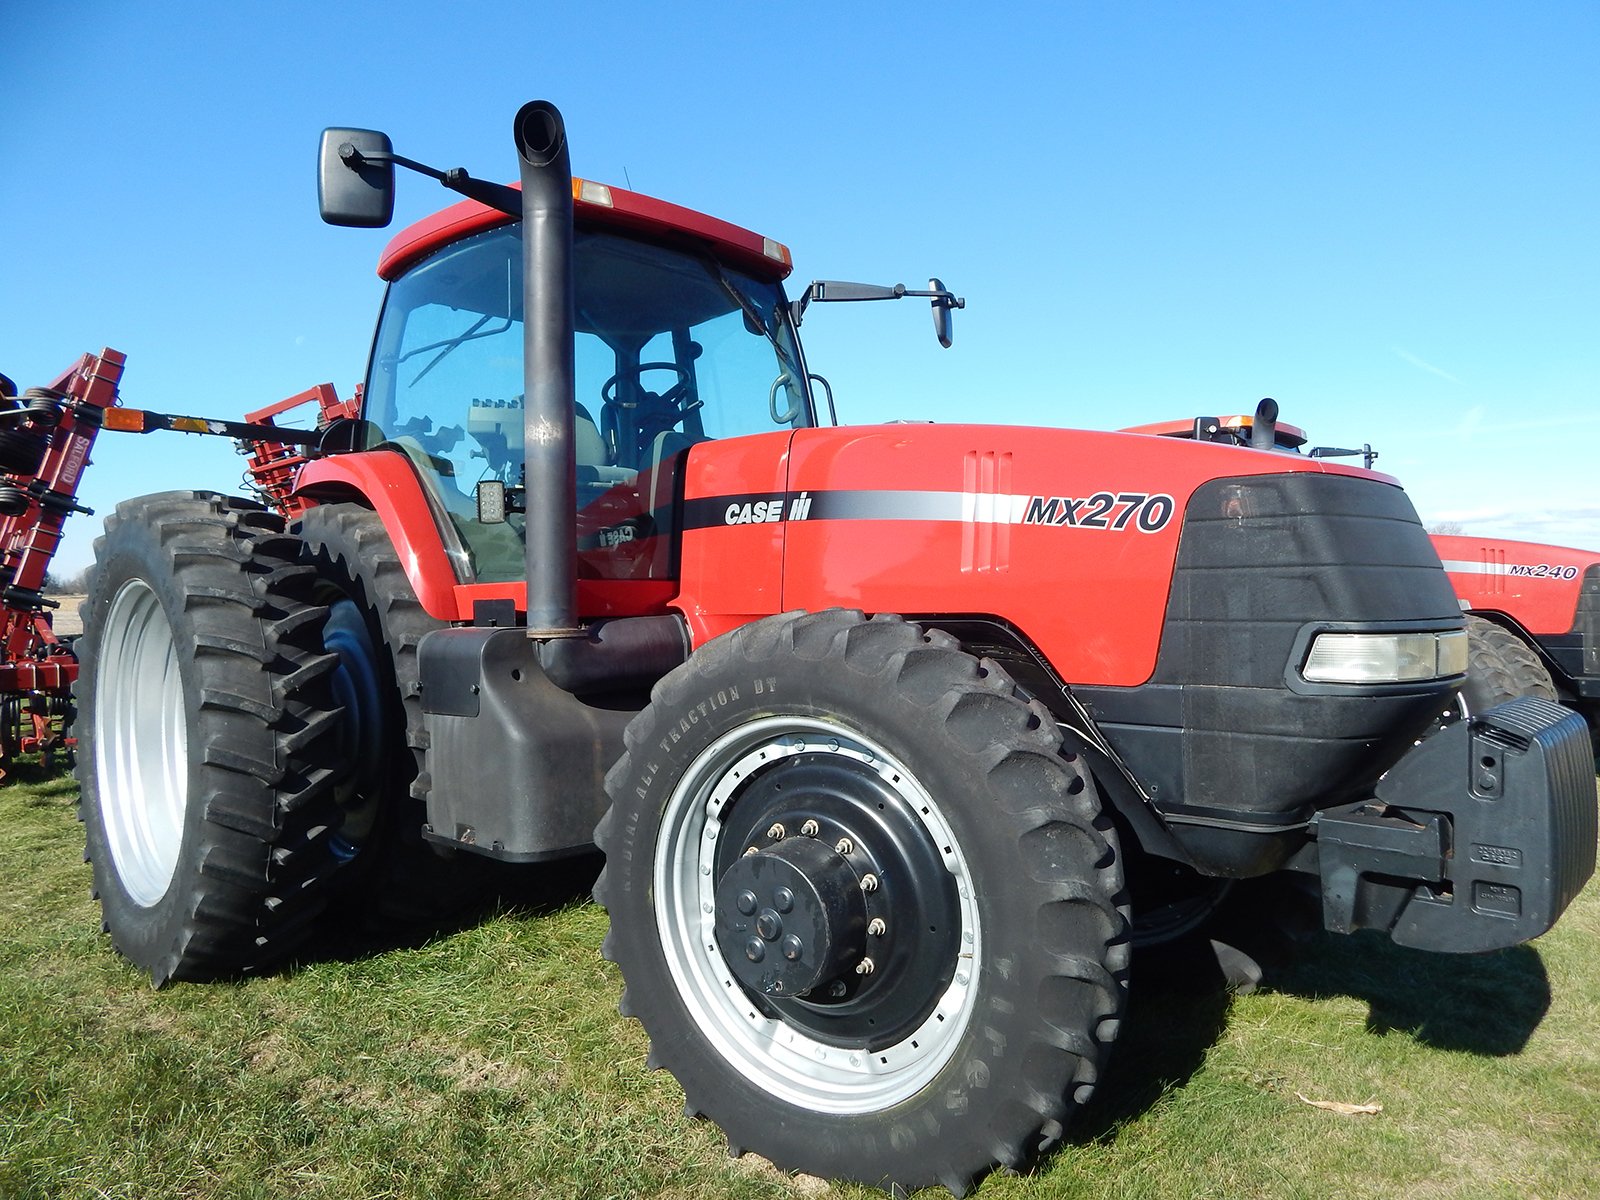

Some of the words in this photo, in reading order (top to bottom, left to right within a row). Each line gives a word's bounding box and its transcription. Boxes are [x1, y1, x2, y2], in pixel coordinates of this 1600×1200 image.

[61, 436, 90, 484] SALFORD
[725, 501, 784, 525] CASE
[1025, 491, 1175, 534] MX270
[1509, 564, 1579, 580] MX240
[635, 763, 660, 800] ALL
[659, 685, 740, 753] TRACTION
[753, 676, 777, 695] DT
